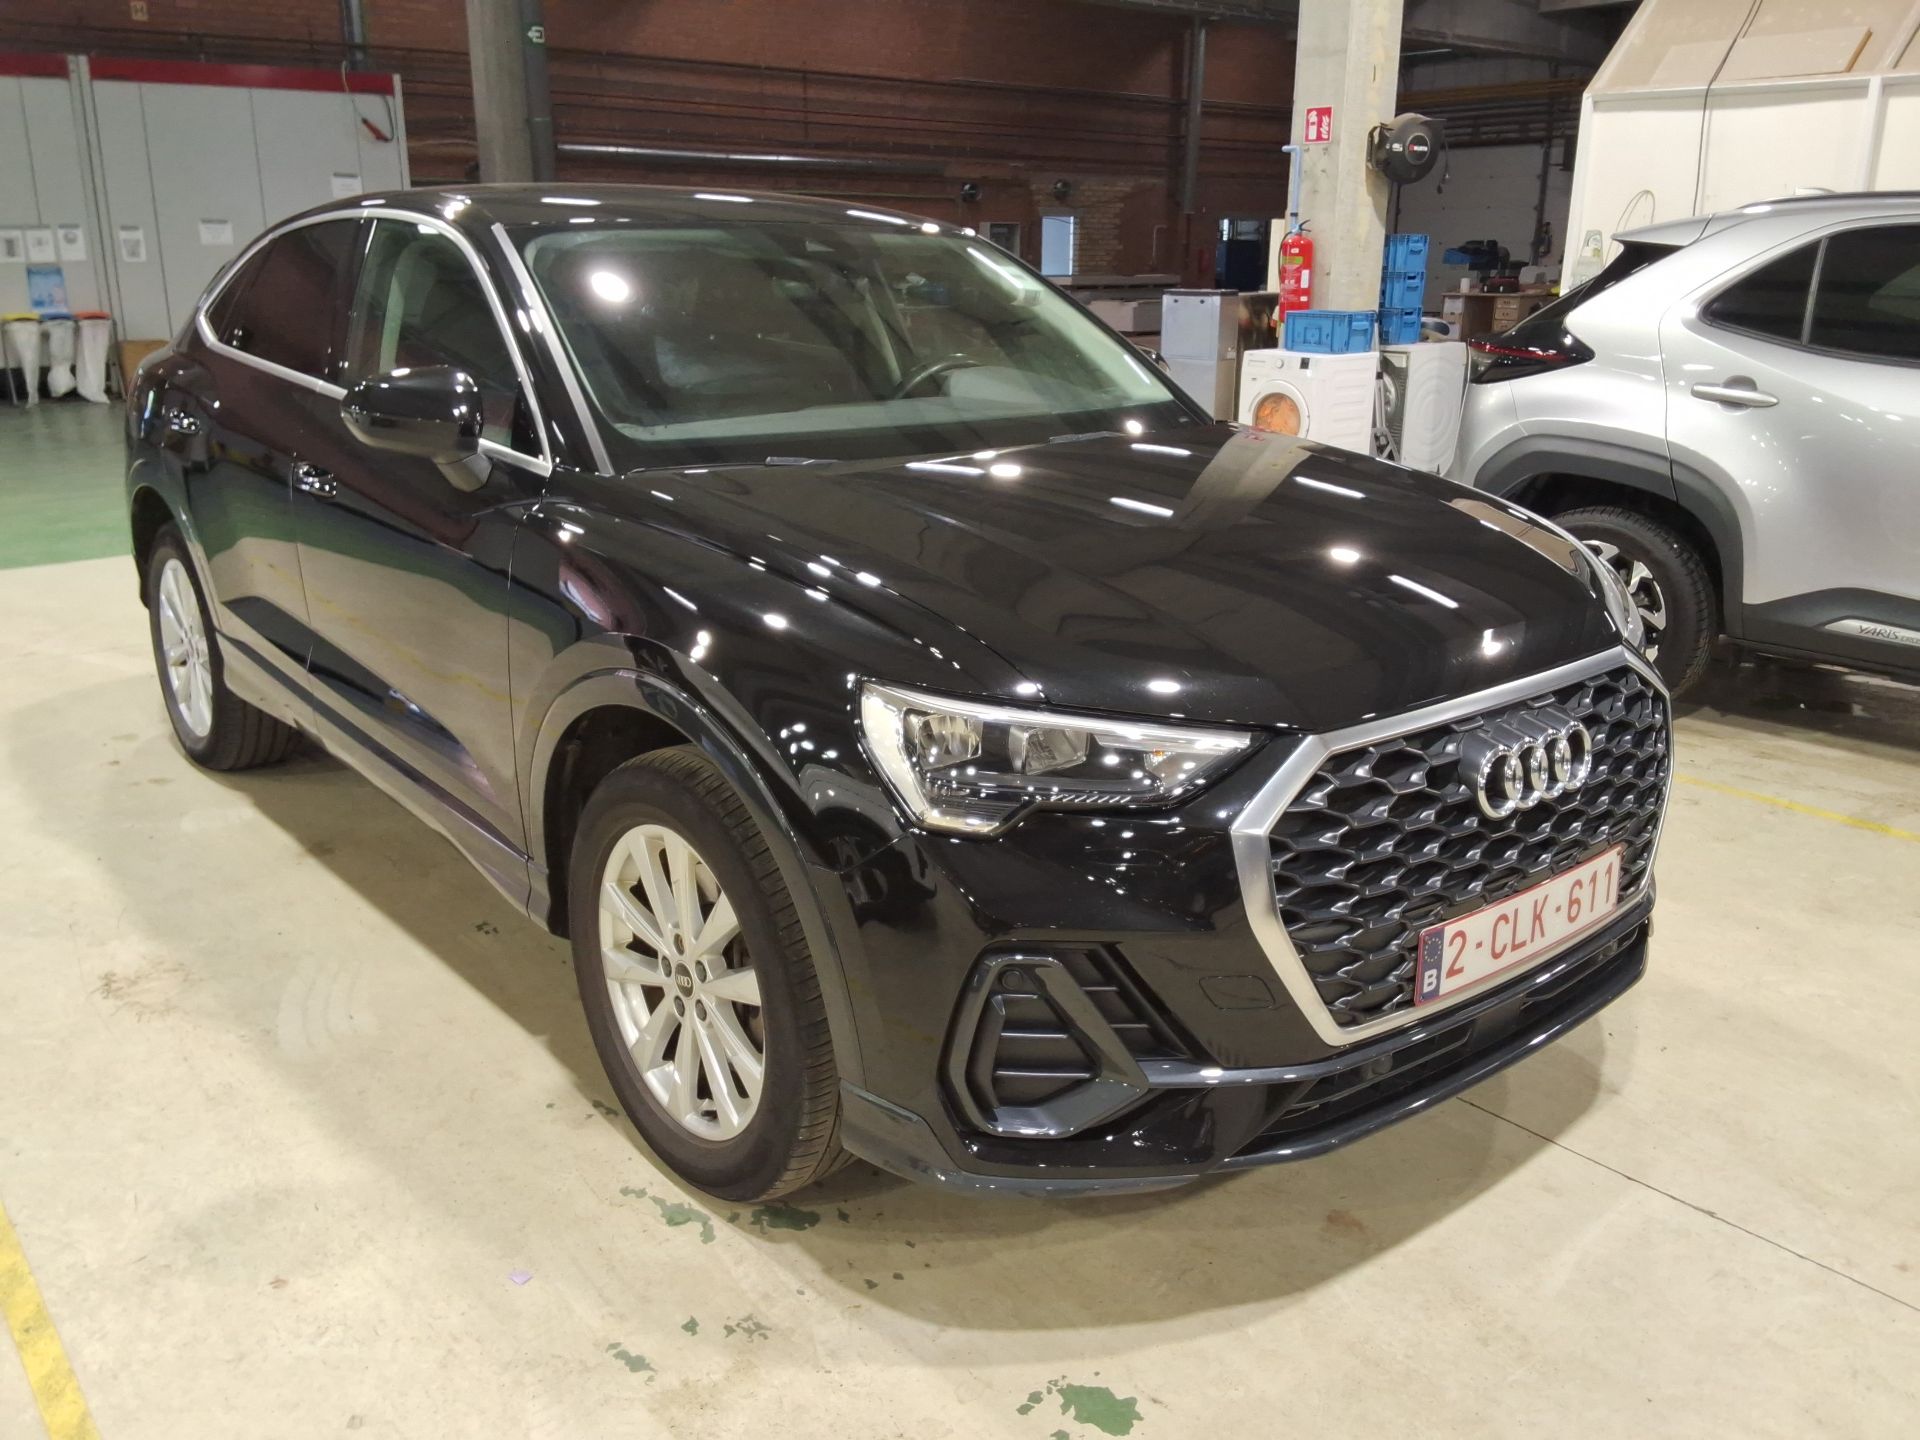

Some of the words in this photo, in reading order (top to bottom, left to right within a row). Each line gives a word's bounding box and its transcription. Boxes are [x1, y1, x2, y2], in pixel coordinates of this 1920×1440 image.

[1858, 625, 1898, 639] YARIS
[1445, 861, 1614, 979] 2-CLK-611
[1423, 968, 1438, 992] B
